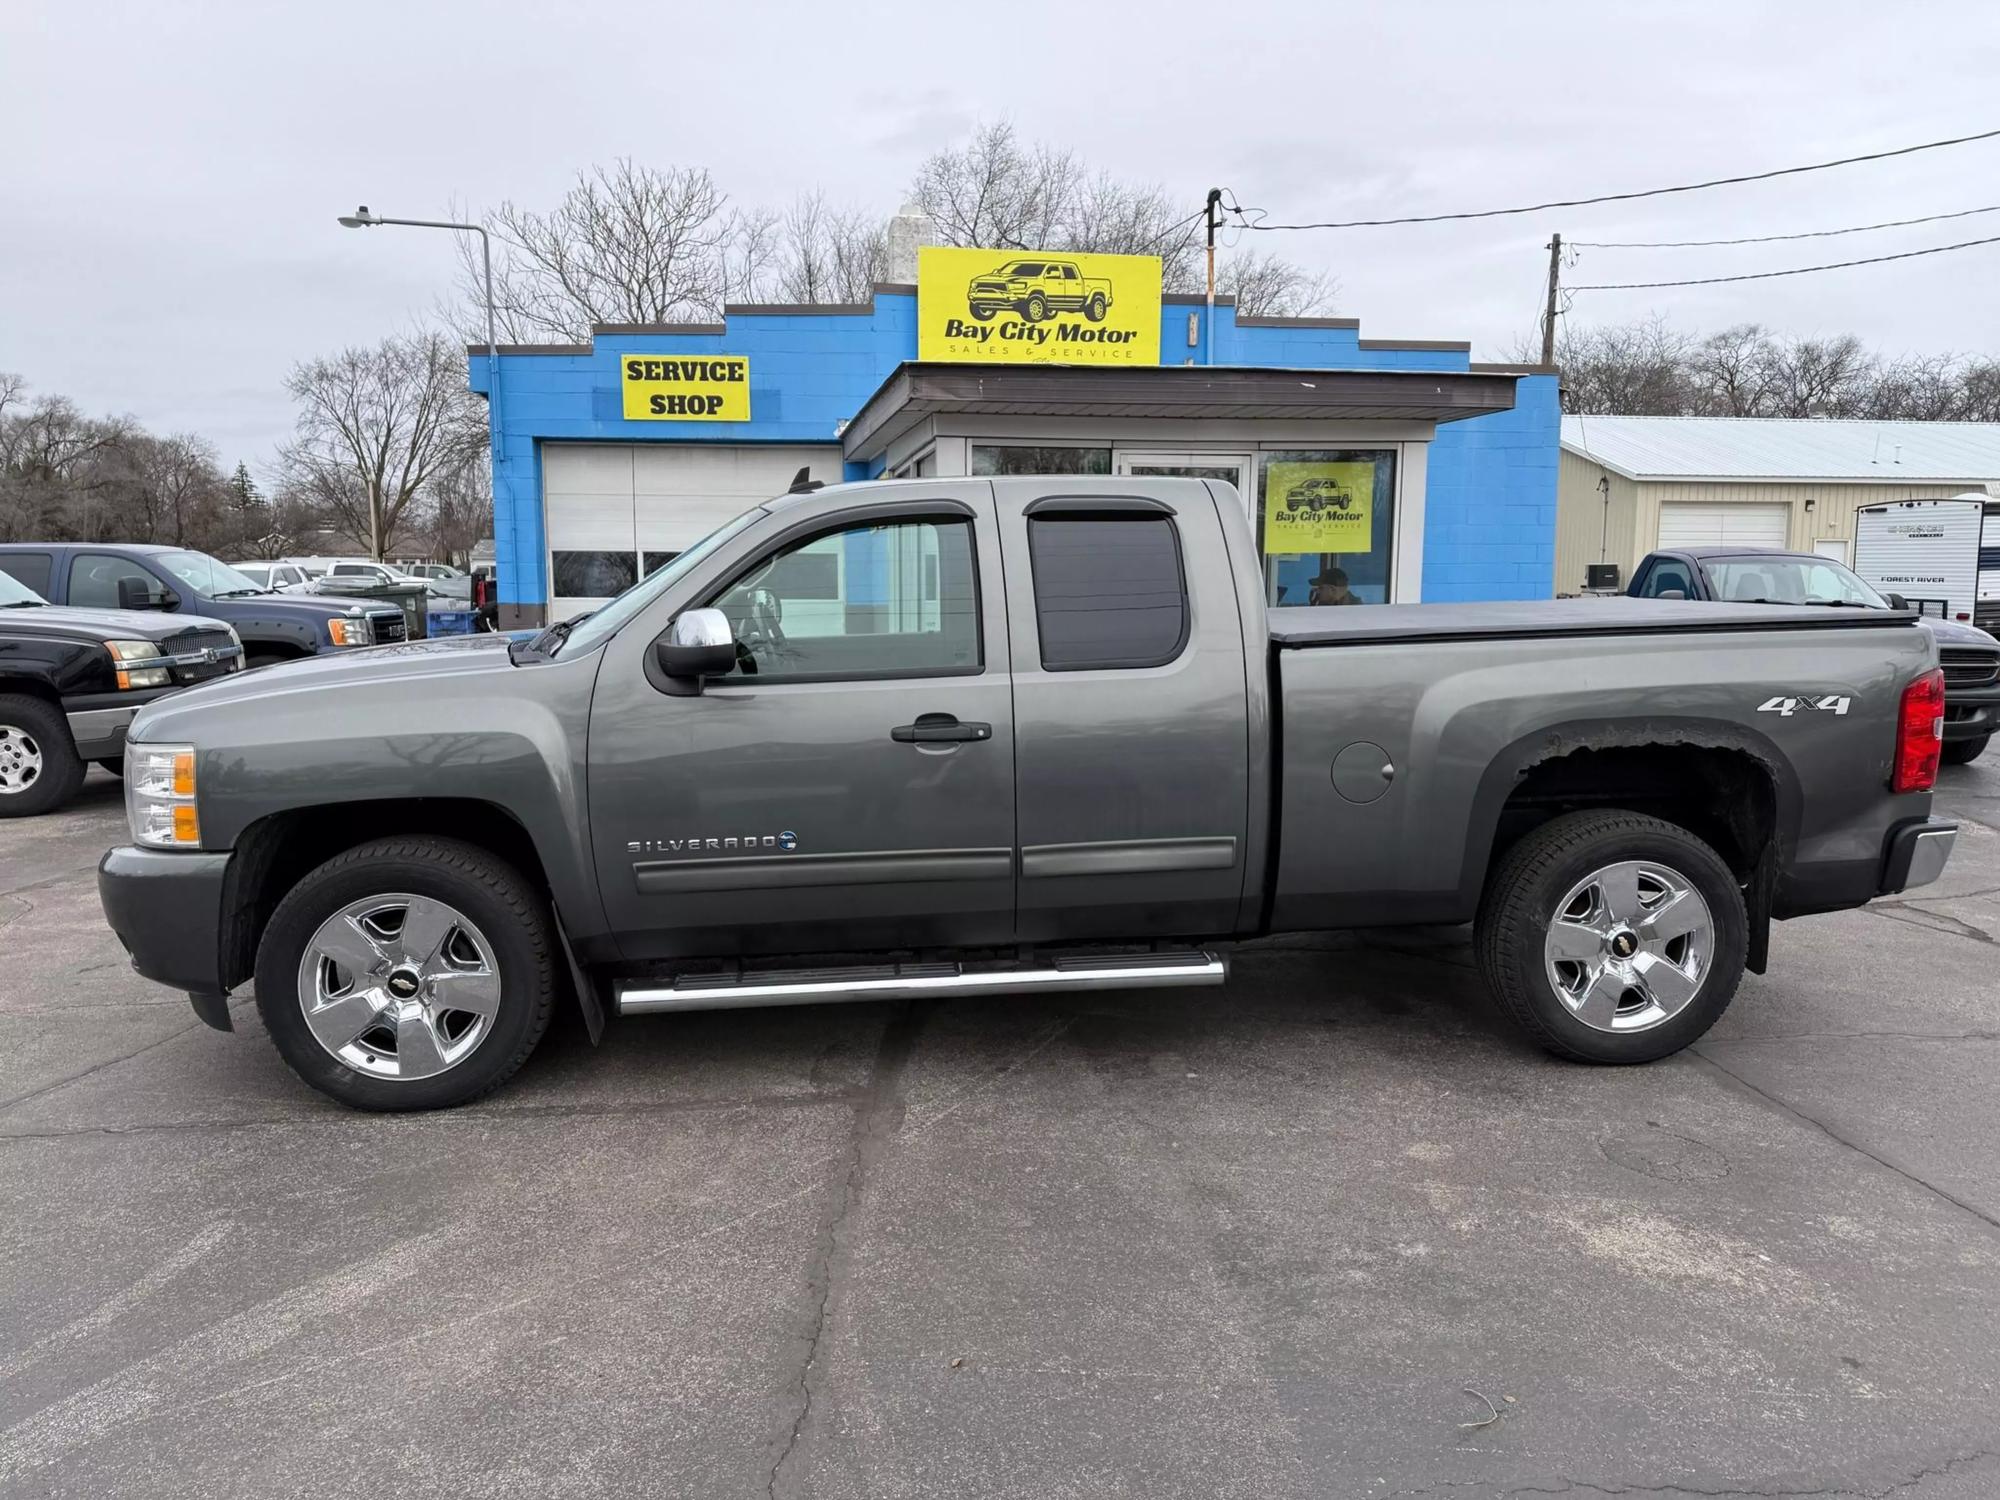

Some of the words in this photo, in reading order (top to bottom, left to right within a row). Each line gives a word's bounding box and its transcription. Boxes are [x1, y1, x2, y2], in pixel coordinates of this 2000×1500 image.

[945, 319, 994, 343] Bay
[999, 321, 1053, 346] City
[1055, 323, 1138, 344] Motor
[949, 344, 1010, 355] SALES
[1025, 346, 1034, 356] &
[1050, 347, 1133, 359] SERVICE
[626, 360, 744, 382] SERVICE
[650, 394, 724, 415] SHOP
[1275, 510, 1298, 523] Bay
[1300, 510, 1324, 523] City
[1325, 511, 1364, 521] Motor
[627, 836, 776, 852] SILVERADO
